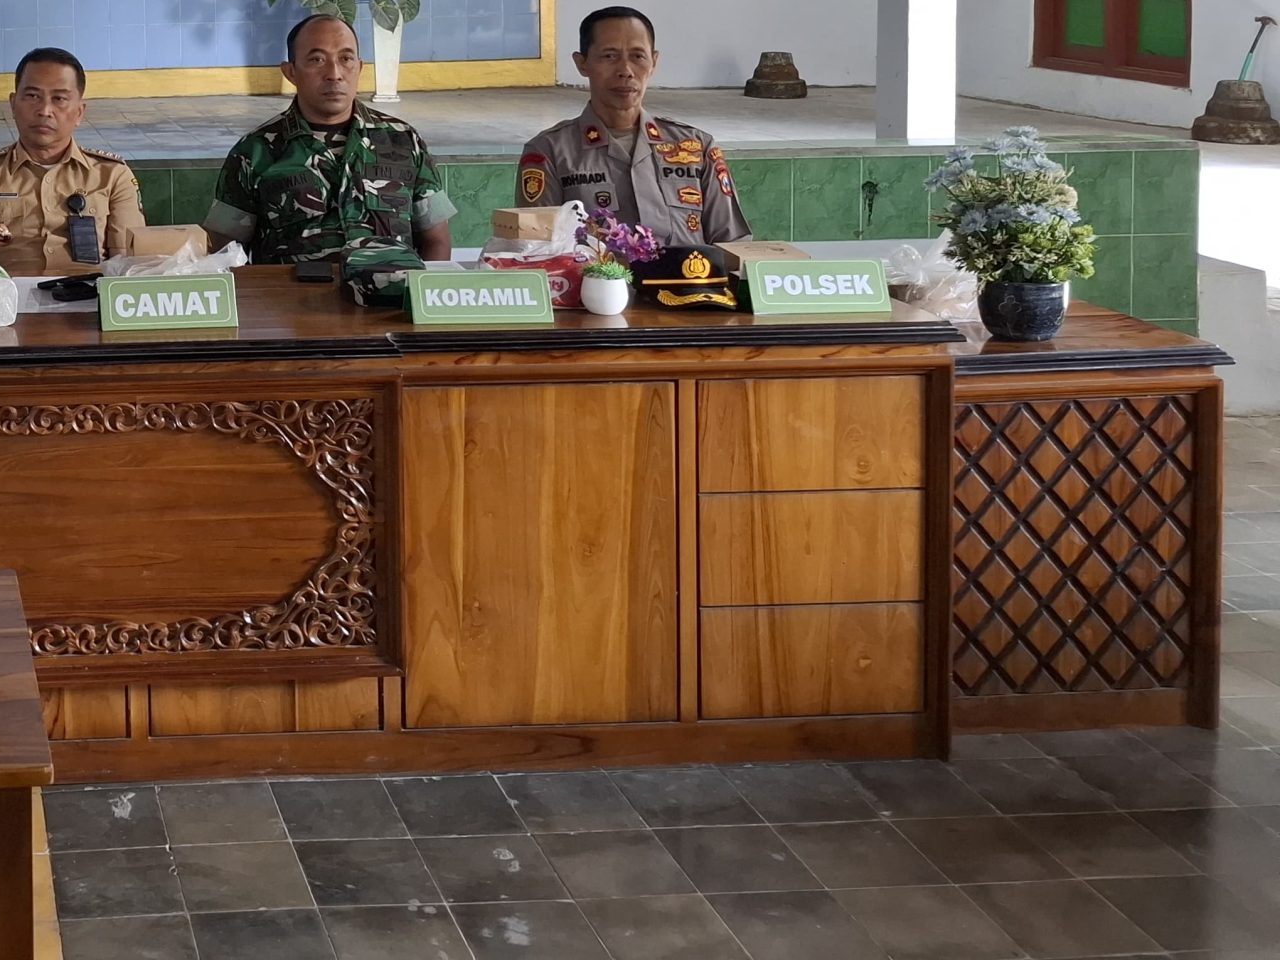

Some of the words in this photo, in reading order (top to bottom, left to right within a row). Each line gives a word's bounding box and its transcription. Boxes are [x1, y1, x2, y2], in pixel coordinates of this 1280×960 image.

[764, 274, 874, 295] POLSEK
[115, 290, 220, 318] CAMAT
[425, 288, 537, 306] KORAMIL
